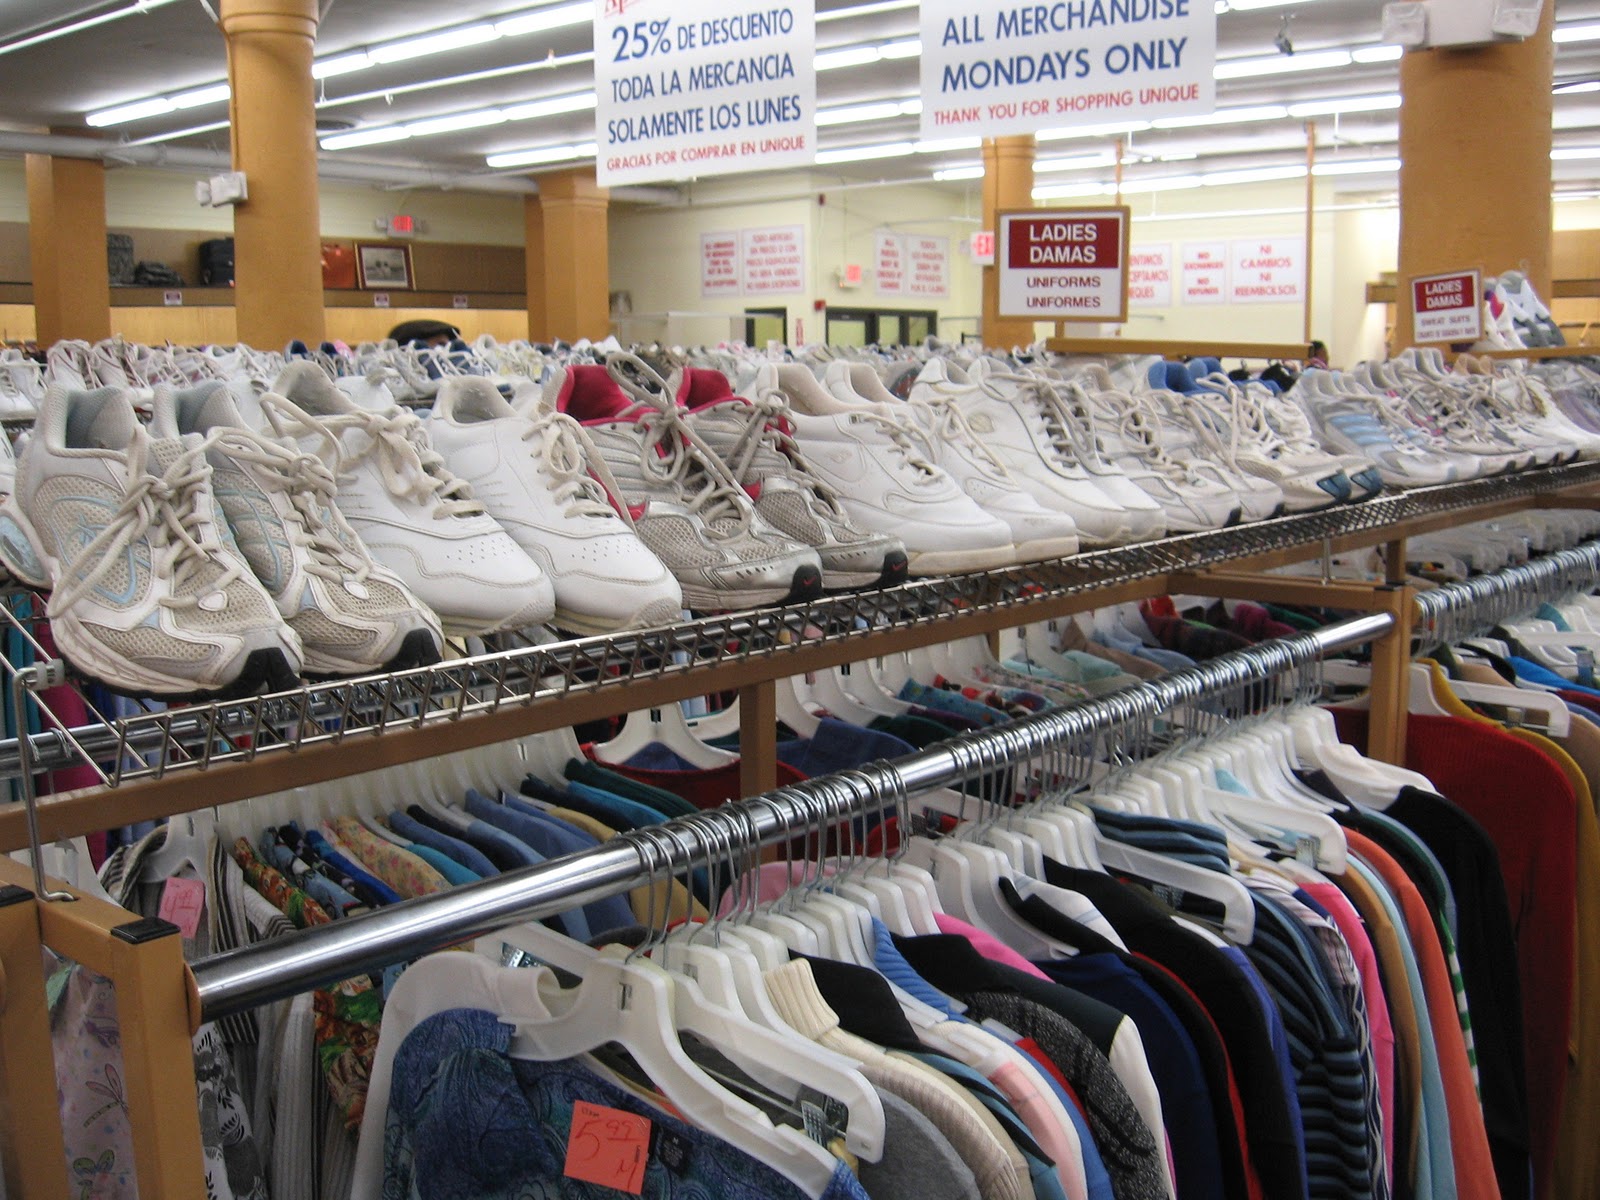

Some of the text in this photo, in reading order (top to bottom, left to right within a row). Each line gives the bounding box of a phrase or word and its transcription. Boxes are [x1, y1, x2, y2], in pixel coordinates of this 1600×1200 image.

[612, 8, 793, 62] 25% DE DESCUENTO
[942, 0, 1190, 46] ALL MERCHANDISE
[612, 52, 795, 103] TODA LA MERCANCIA
[942, 36, 1188, 93] MONDAYS ONLY
[608, 95, 801, 144] SOLAMENTE LOS LUNES
[934, 83, 1199, 125] THANK YOU FOR SHOPPING UNIQUE
[607, 134, 805, 171] GRACIAS POR COMPRAR EN UNIQUE
[1029, 223, 1098, 242] LADIES
[1029, 245, 1097, 264] DAMAS
[1026, 276, 1101, 289] UNIFORMS
[1425, 280, 1463, 295] LADIES
[1426, 293, 1463, 309] DAMAS
[1026, 296, 1101, 309] UNIFORMES
